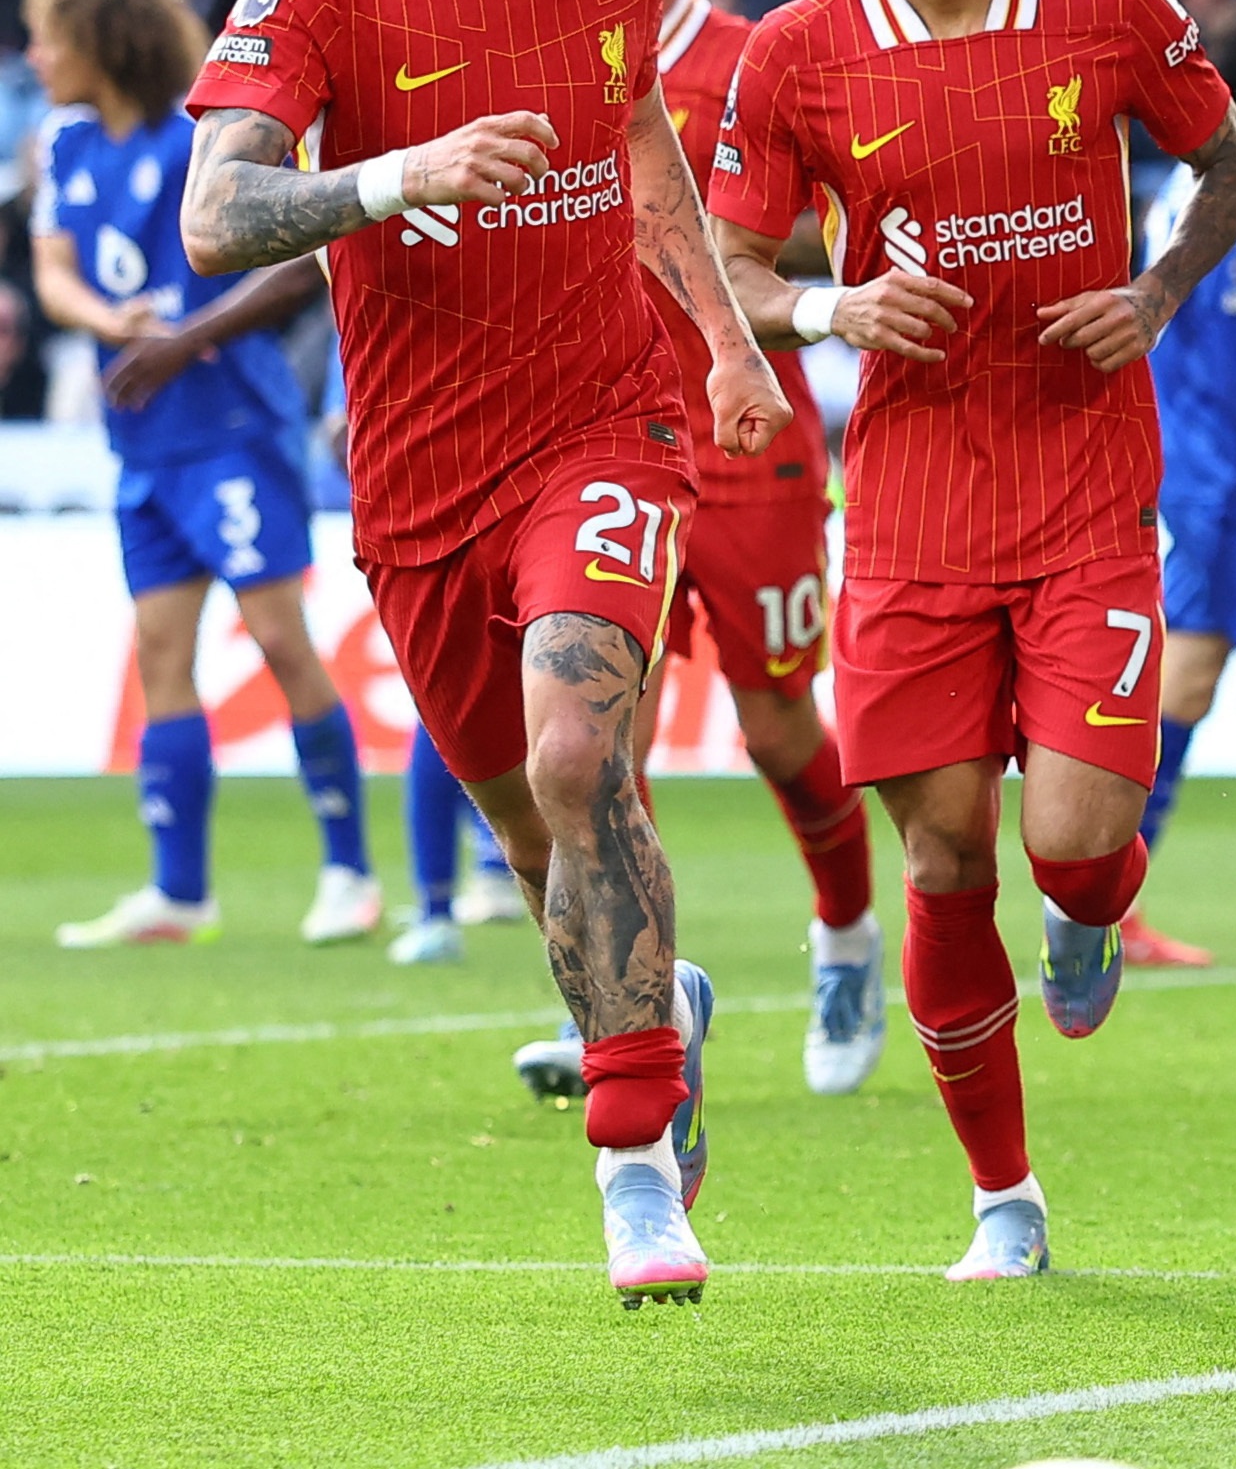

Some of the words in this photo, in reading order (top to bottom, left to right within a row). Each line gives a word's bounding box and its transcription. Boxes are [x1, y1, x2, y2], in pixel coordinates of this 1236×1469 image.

[496, 149, 619, 197] andard
[477, 179, 623, 229] chartered
[935, 193, 1084, 243] standard
[938, 218, 1094, 269] chartered
[215, 478, 261, 546] 3
[575, 482, 663, 583] 21
[756, 574, 824, 654] 10
[1107, 609, 1152, 697] 7
